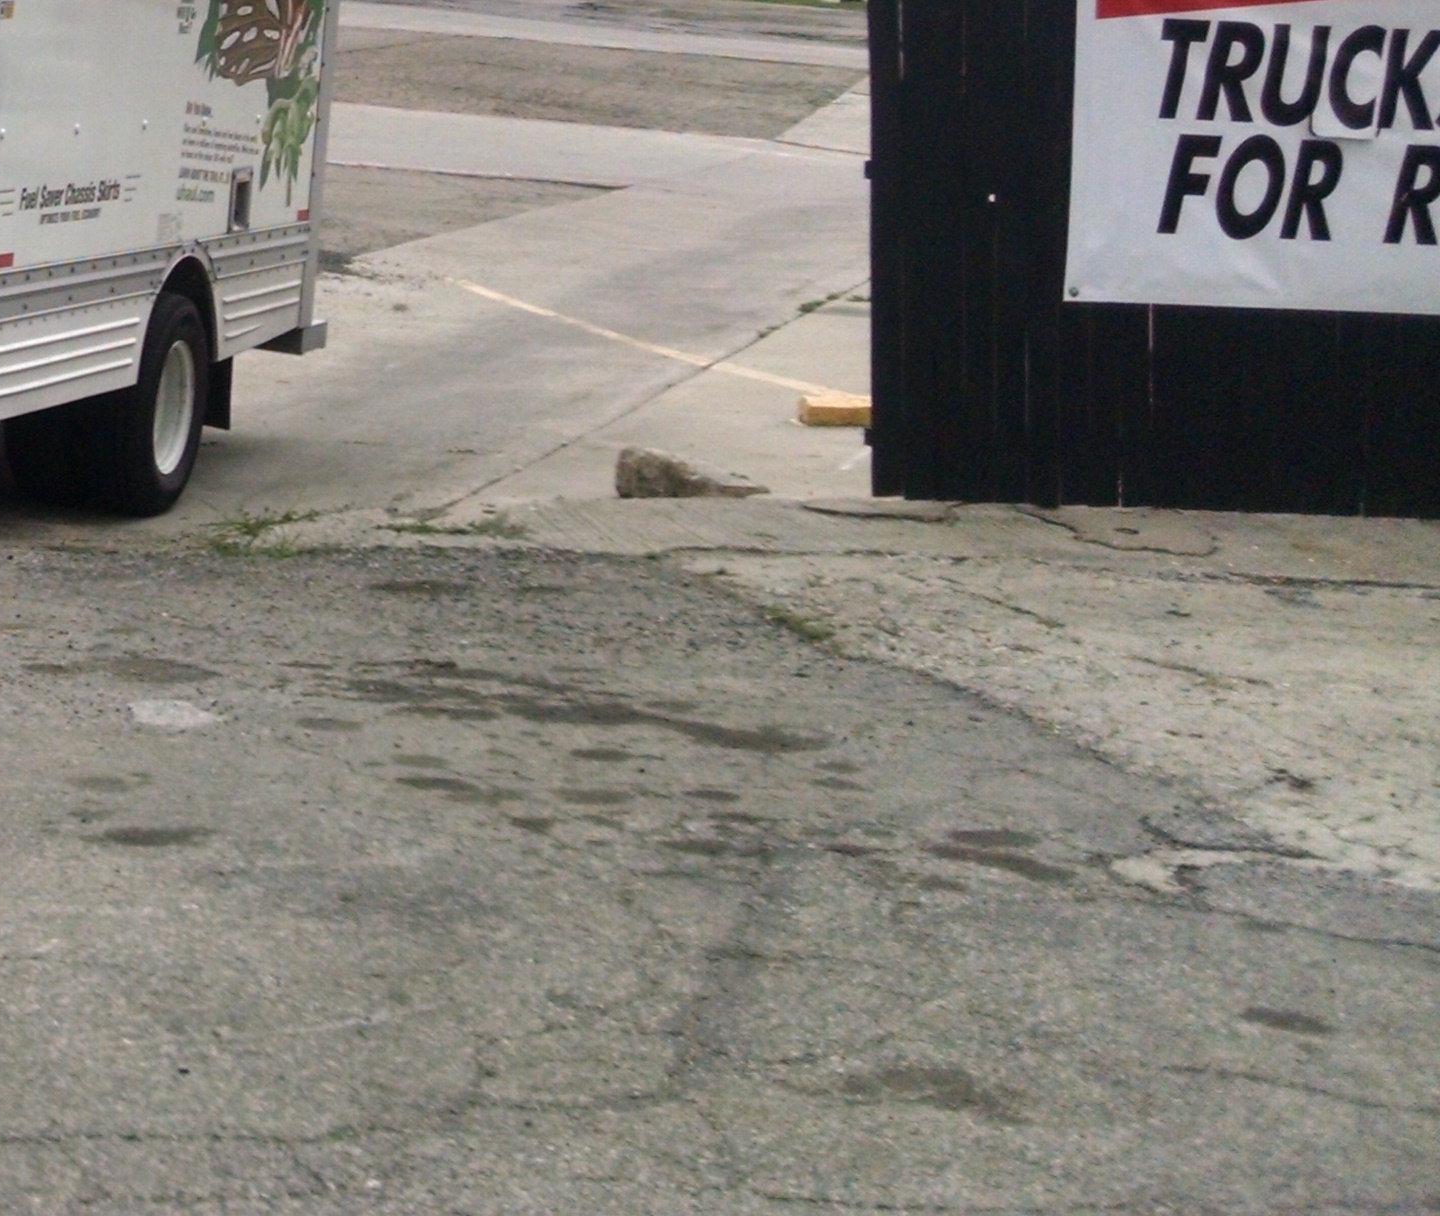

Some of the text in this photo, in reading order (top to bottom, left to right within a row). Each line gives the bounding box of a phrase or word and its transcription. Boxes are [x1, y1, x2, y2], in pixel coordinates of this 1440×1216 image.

[1158, 17, 1440, 131] TRUCK
[19, 179, 121, 211] Fuel Saver Chassis Skirts
[1156, 133, 1344, 241] FOR
